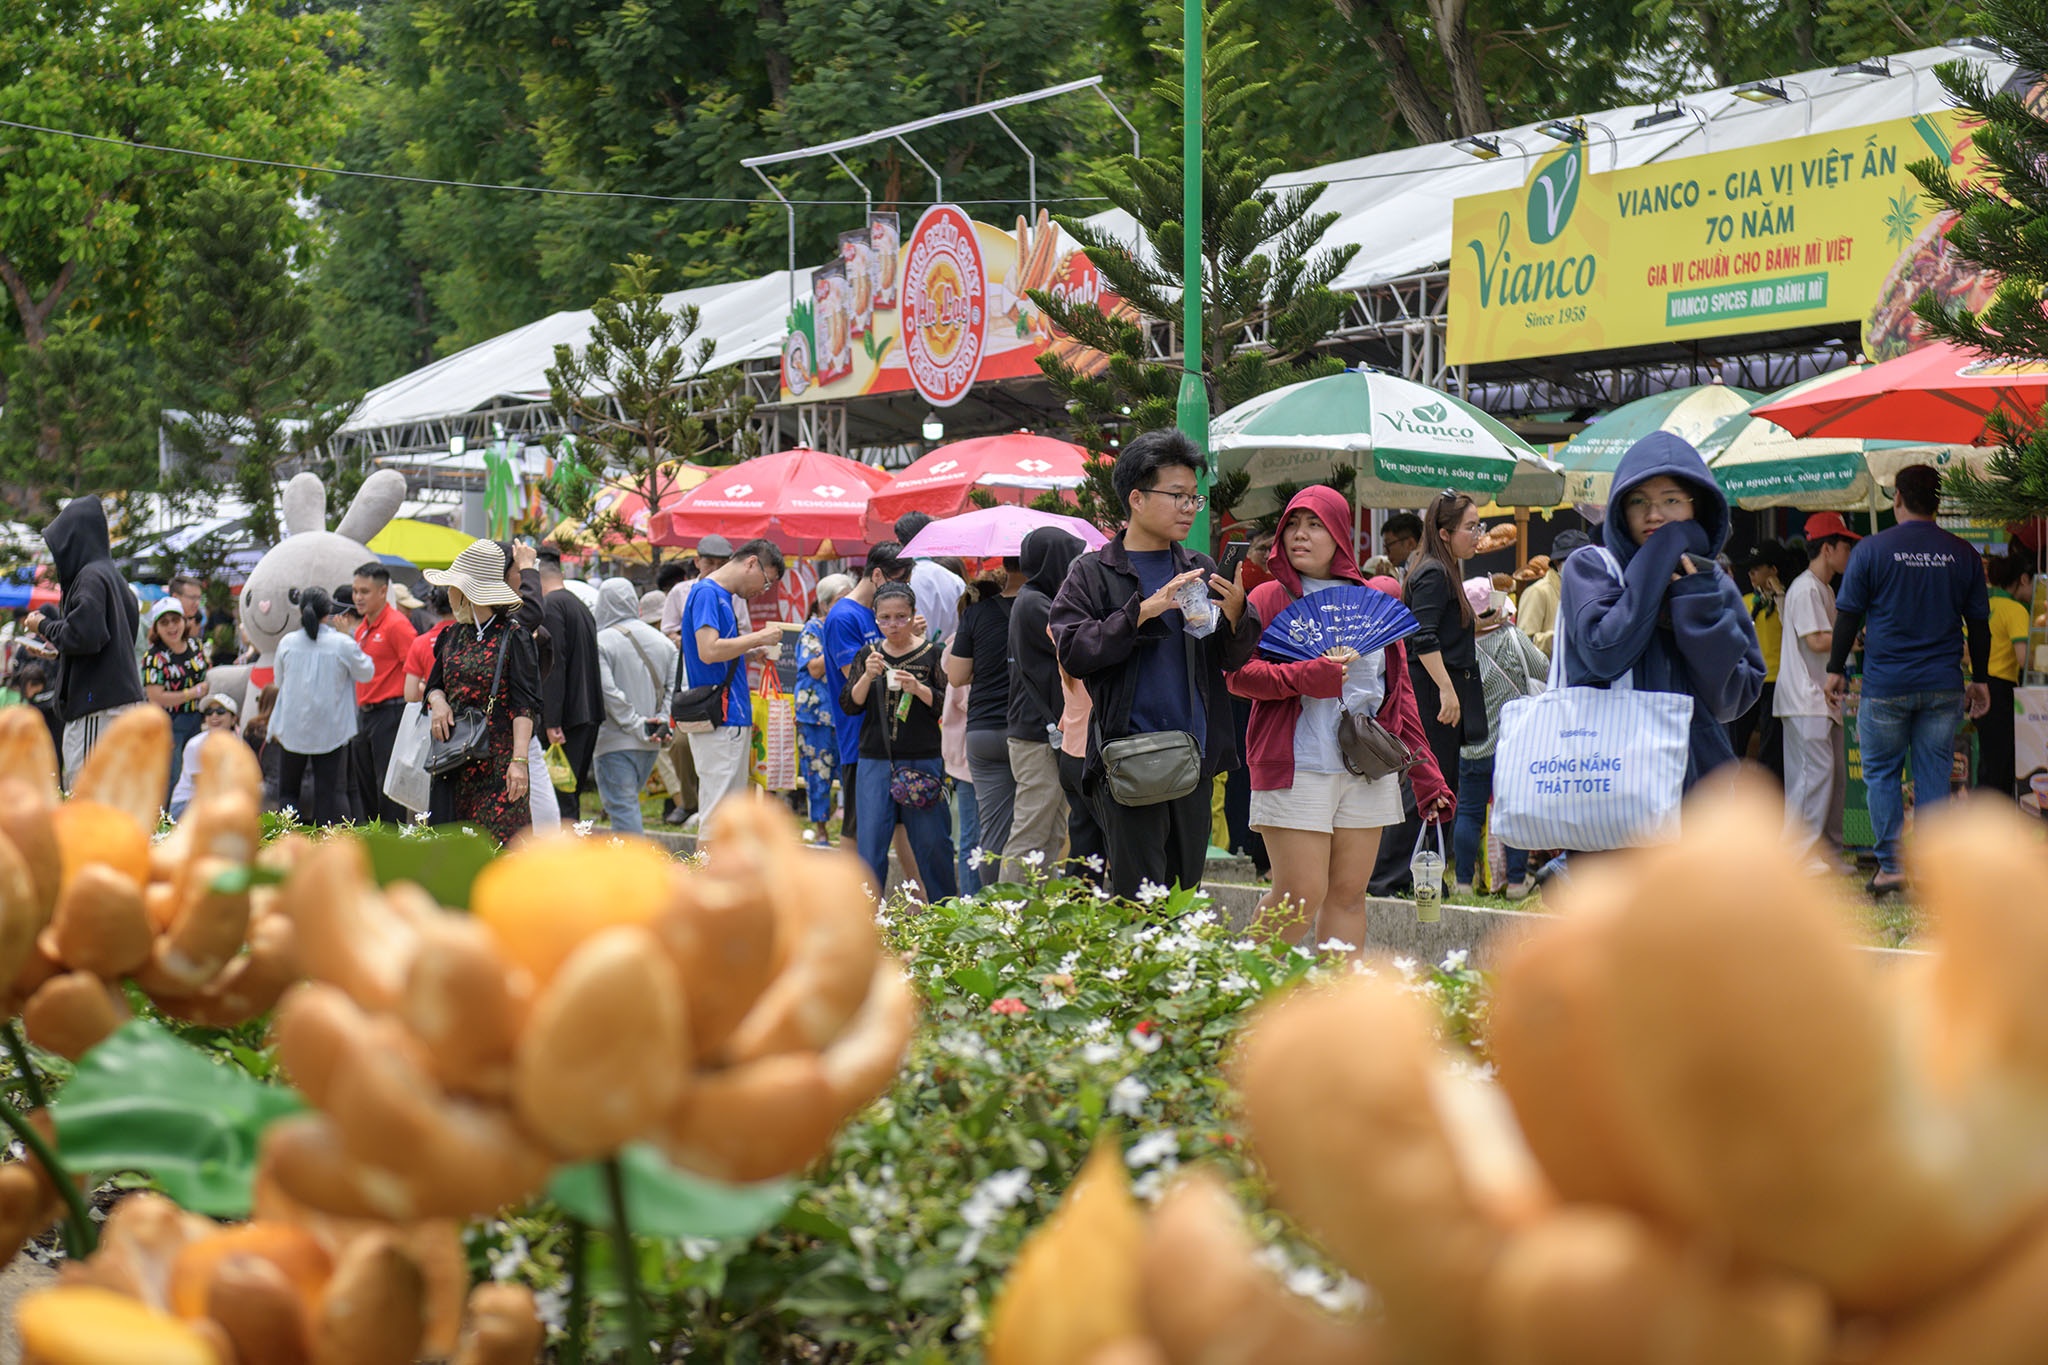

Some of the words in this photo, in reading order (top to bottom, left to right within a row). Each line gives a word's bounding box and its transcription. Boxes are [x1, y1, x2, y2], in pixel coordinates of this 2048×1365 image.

[1617, 180, 1700, 218] VIANCO
[1724, 169, 1762, 202] GIA
[1771, 163, 1793, 196] VỊ
[1801, 147, 1854, 188] VIỆT
[1861, 134, 1897, 179] ẤN
[1705, 215, 1734, 245] 70
[1741, 200, 1795, 239] NĂM
[956, 236, 981, 297] CHAY
[1467, 211, 1596, 309] Vianco
[1647, 264, 1668, 287] GIA
[1672, 261, 1684, 288] VỊ
[1733, 251, 1761, 275] CHO
[1804, 237, 1824, 266] MÌ
[1826, 234, 1853, 266] VIỆT
[1525, 312, 1554, 328] Since
[1558, 305, 1588, 324] 1958
[1671, 295, 1709, 318] VIANCO
[1711, 289, 1748, 313] SPICES
[1750, 287, 1773, 308] AND
[1775, 279, 1805, 305] BÁNH
[1807, 276, 1825, 301] MÌ
[908, 335, 947, 396] VEGAN
[949, 332, 978, 393] FOOD
[1377, 410, 1474, 438] Vianco
[1477, 472, 1490, 480] an
[1493, 472, 1508, 483] vui
[1822, 471, 1836, 480] an
[1529, 754, 1577, 775] CHỐNG
[1580, 751, 1622, 772] NẮNG
[1536, 777, 1571, 797] THẬT
[1573, 778, 1611, 793] TOTE
